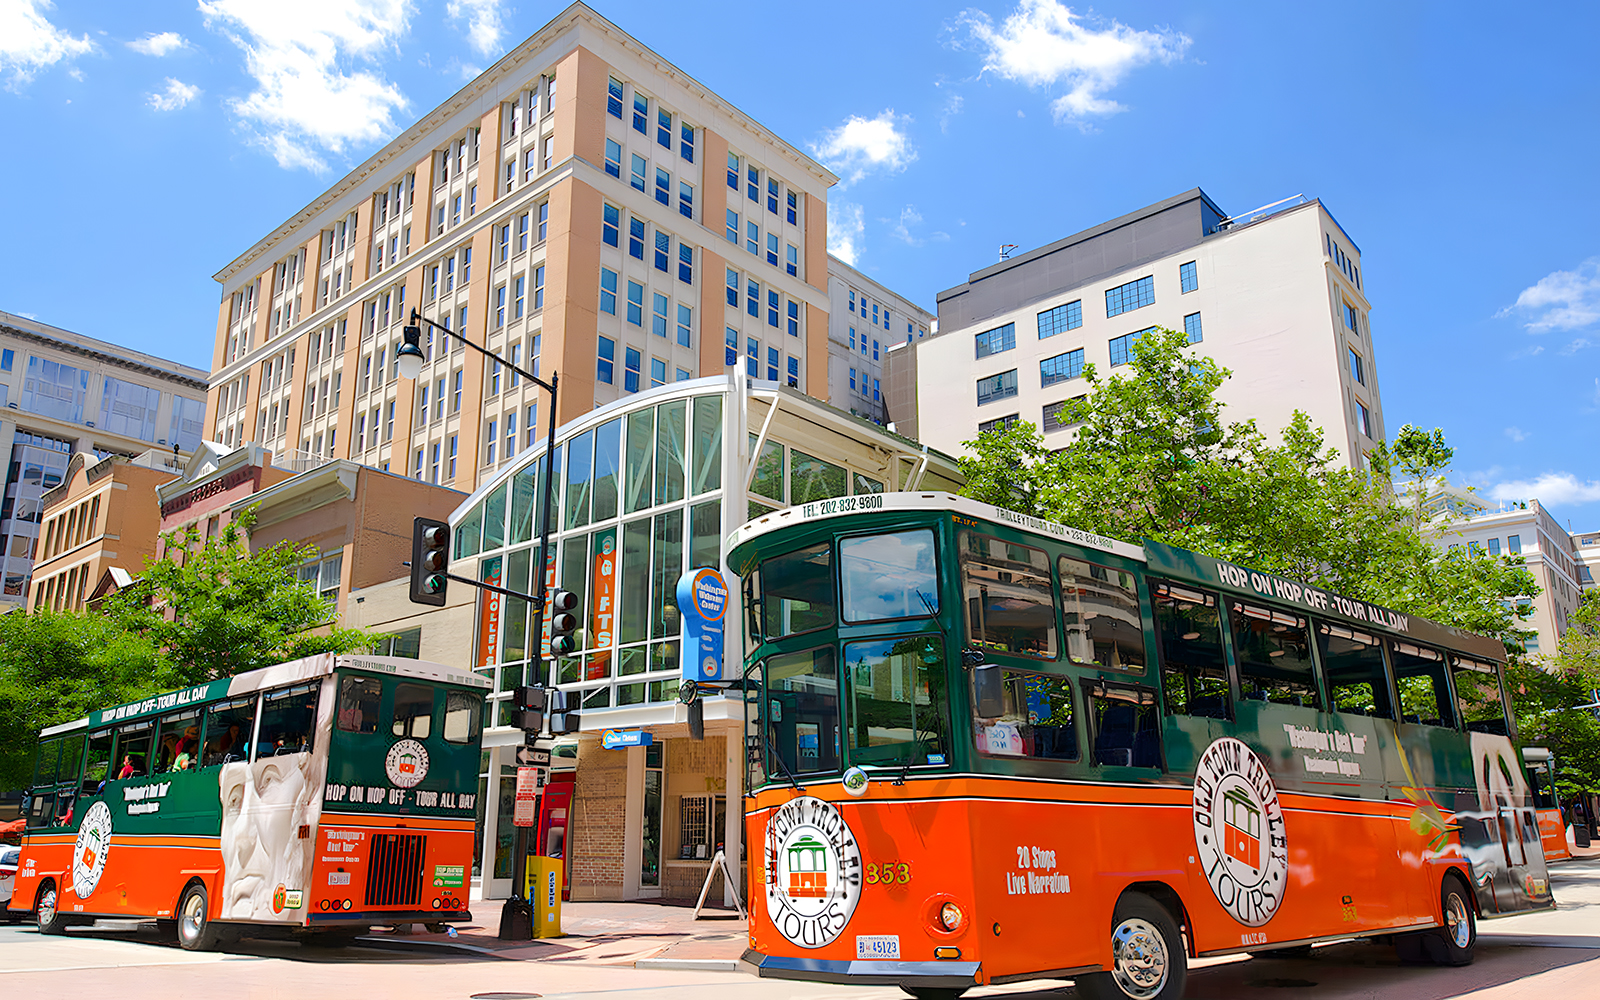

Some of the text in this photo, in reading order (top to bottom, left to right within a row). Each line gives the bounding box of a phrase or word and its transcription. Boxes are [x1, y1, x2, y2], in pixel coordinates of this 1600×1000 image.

[597, 559, 613, 648] GIFTS
[1216, 563, 1248, 588] HOP
[1251, 572, 1273, 596] ON
[1273, 579, 1302, 603] HOP
[1304, 588, 1328, 611] OFF
[1368, 605, 1388, 627] ALL
[1388, 612, 1409, 633] DAY
[177, 690, 191, 705] ALL
[192, 685, 209, 701] DAY
[1203, 741, 1241, 783] TOWN
[325, 783, 347, 801] HOP
[349, 785, 364, 803] ON
[367, 787, 386, 804] HOP
[388, 788, 406, 805] OFF
[416, 790, 438, 808] TOUR
[440, 793, 456, 809] ALL
[458, 794, 476, 810] DAY
[1195, 775, 1213, 828] OLD
[1247, 751, 1287, 869] TROLLEY
[865, 862, 911, 885] 353
[1016, 846, 1056, 872] 20 Stops
[1006, 871, 1070, 895] Live Narration
[1208, 848, 1277, 923] TOURS
[774, 898, 846, 946] TOURS
[872, 941, 898, 954] 45123
